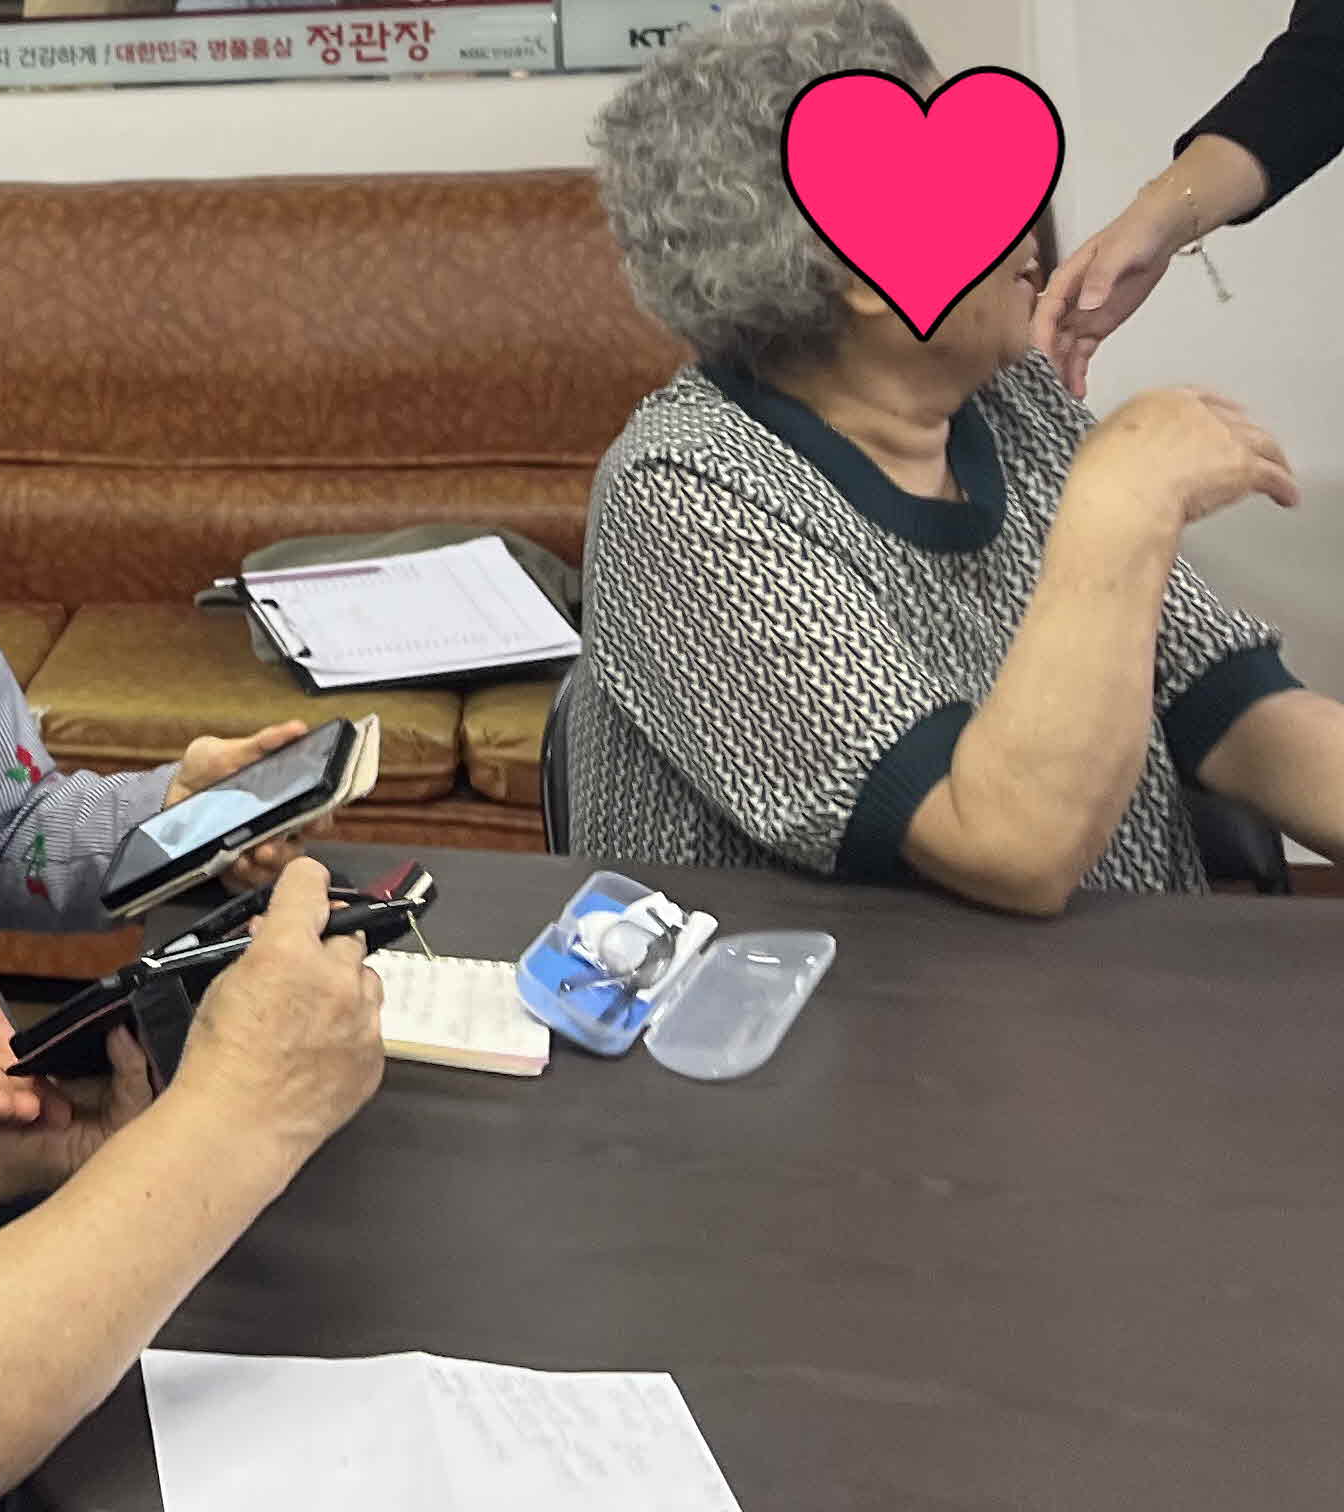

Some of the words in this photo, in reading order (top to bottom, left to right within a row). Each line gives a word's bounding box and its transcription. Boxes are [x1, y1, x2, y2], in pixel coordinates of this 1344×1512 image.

[17, 44, 98, 68] 건강하게
[114, 38, 198, 64] 대한민국
[305, 19, 437, 66] 정관장
